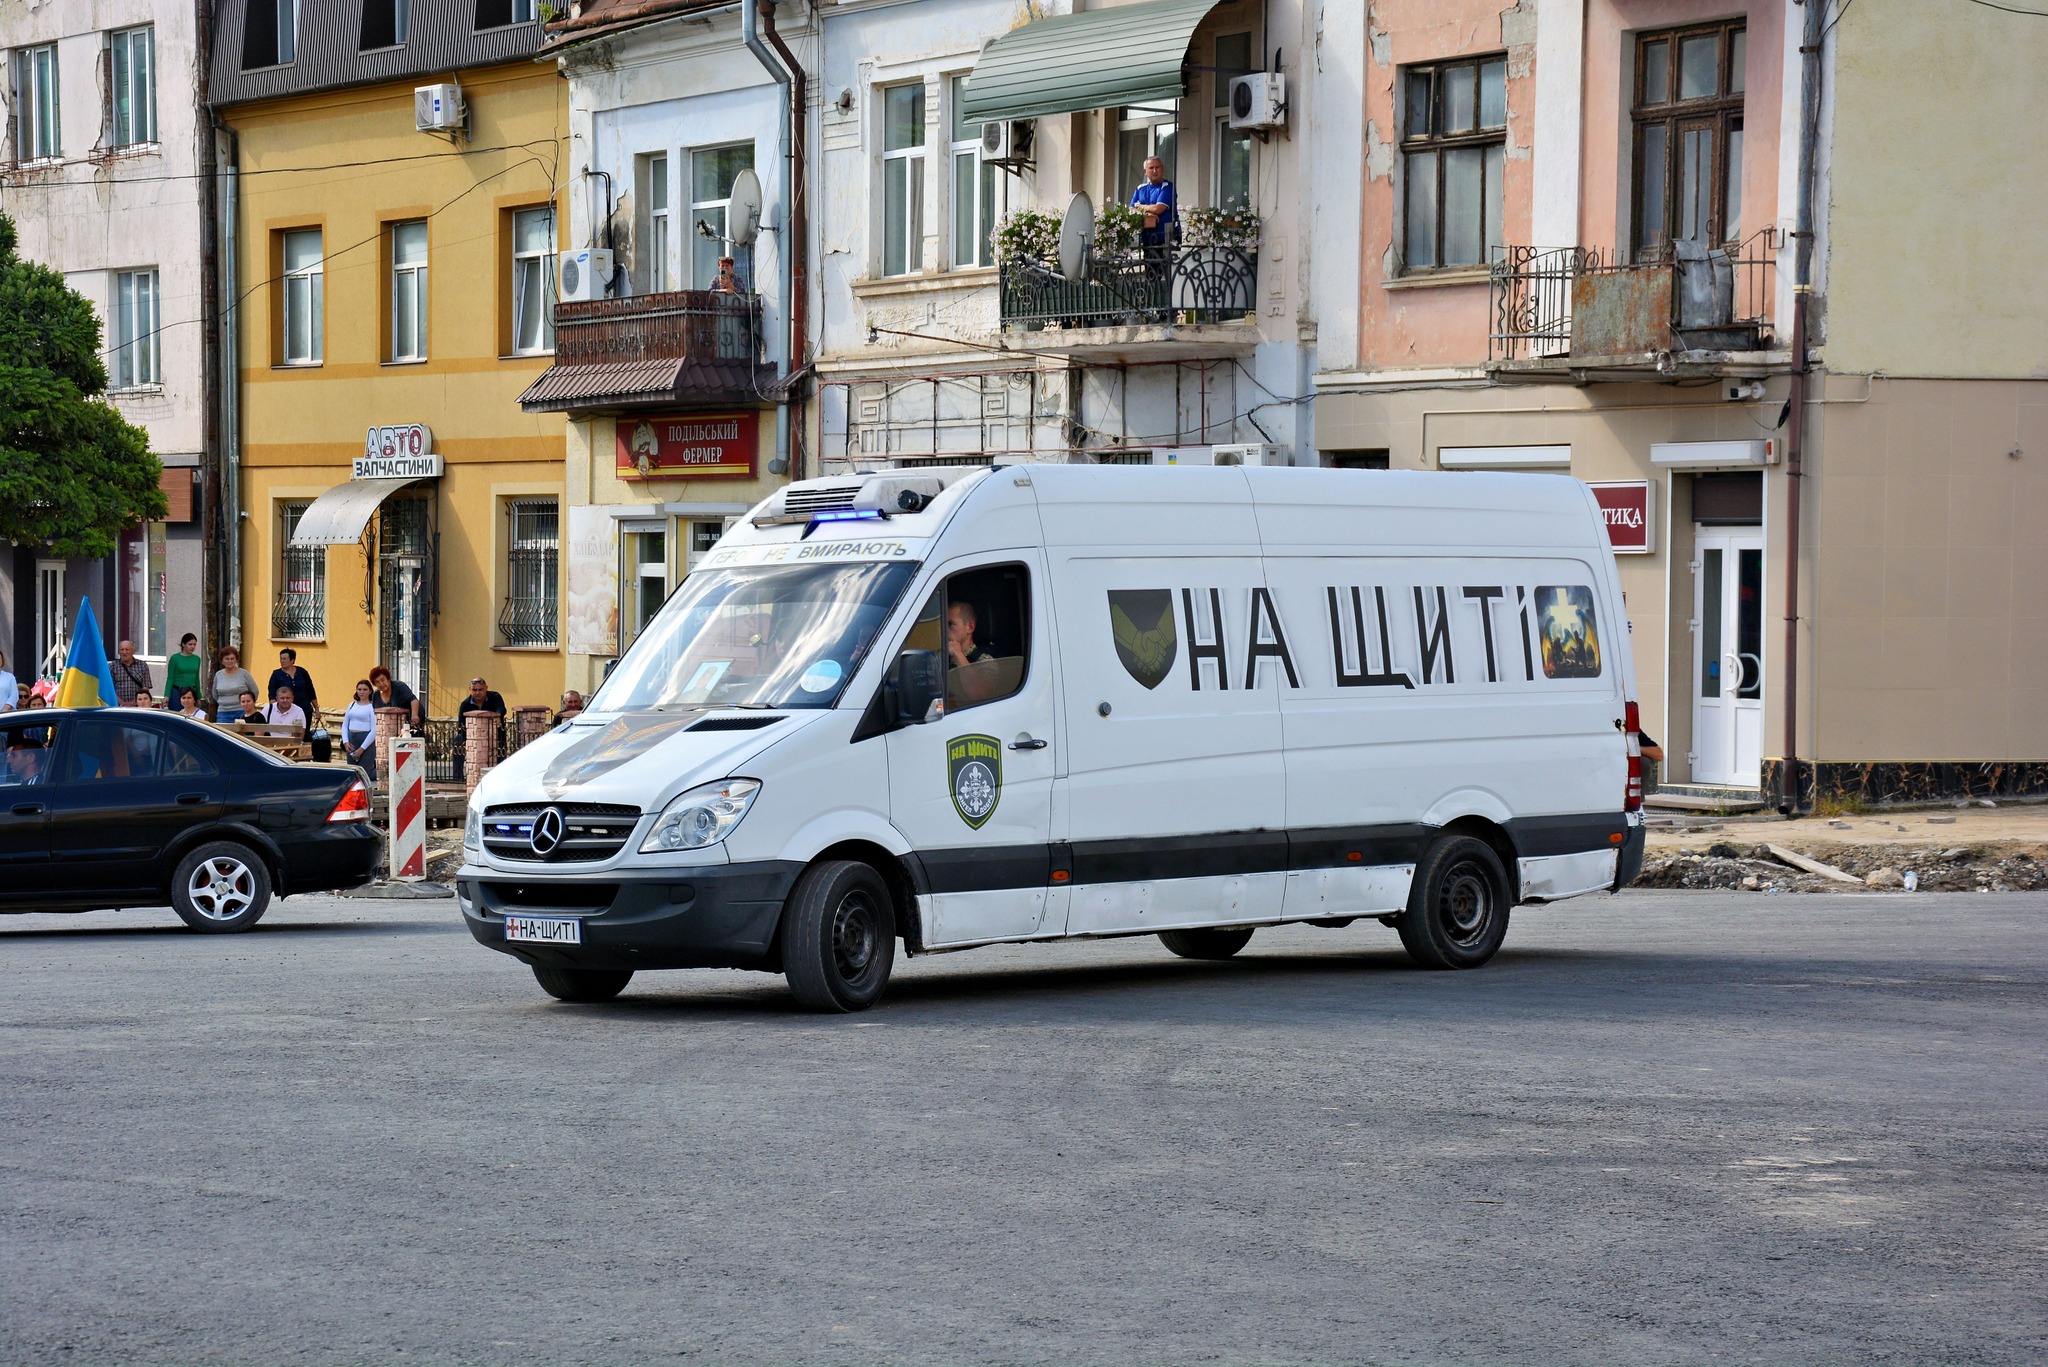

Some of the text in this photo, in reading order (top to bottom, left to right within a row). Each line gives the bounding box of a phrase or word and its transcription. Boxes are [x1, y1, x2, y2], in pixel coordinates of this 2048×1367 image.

[668, 420, 738, 443] ПОДІЛЬСЬКИЙ
[365, 424, 424, 458] АВТО
[683, 447, 722, 464] ФЕРМЕР
[355, 459, 433, 476] ЗАПЧАСТИНИ
[763, 547, 790, 561] НЕ
[797, 542, 907, 559] ВМИРАЮТЬ
[1181, 585, 1535, 690] НА ЩИТІ
[951, 744, 966, 760] НА
[958, 795, 994, 813] АНГЕЛ ДОБРА
